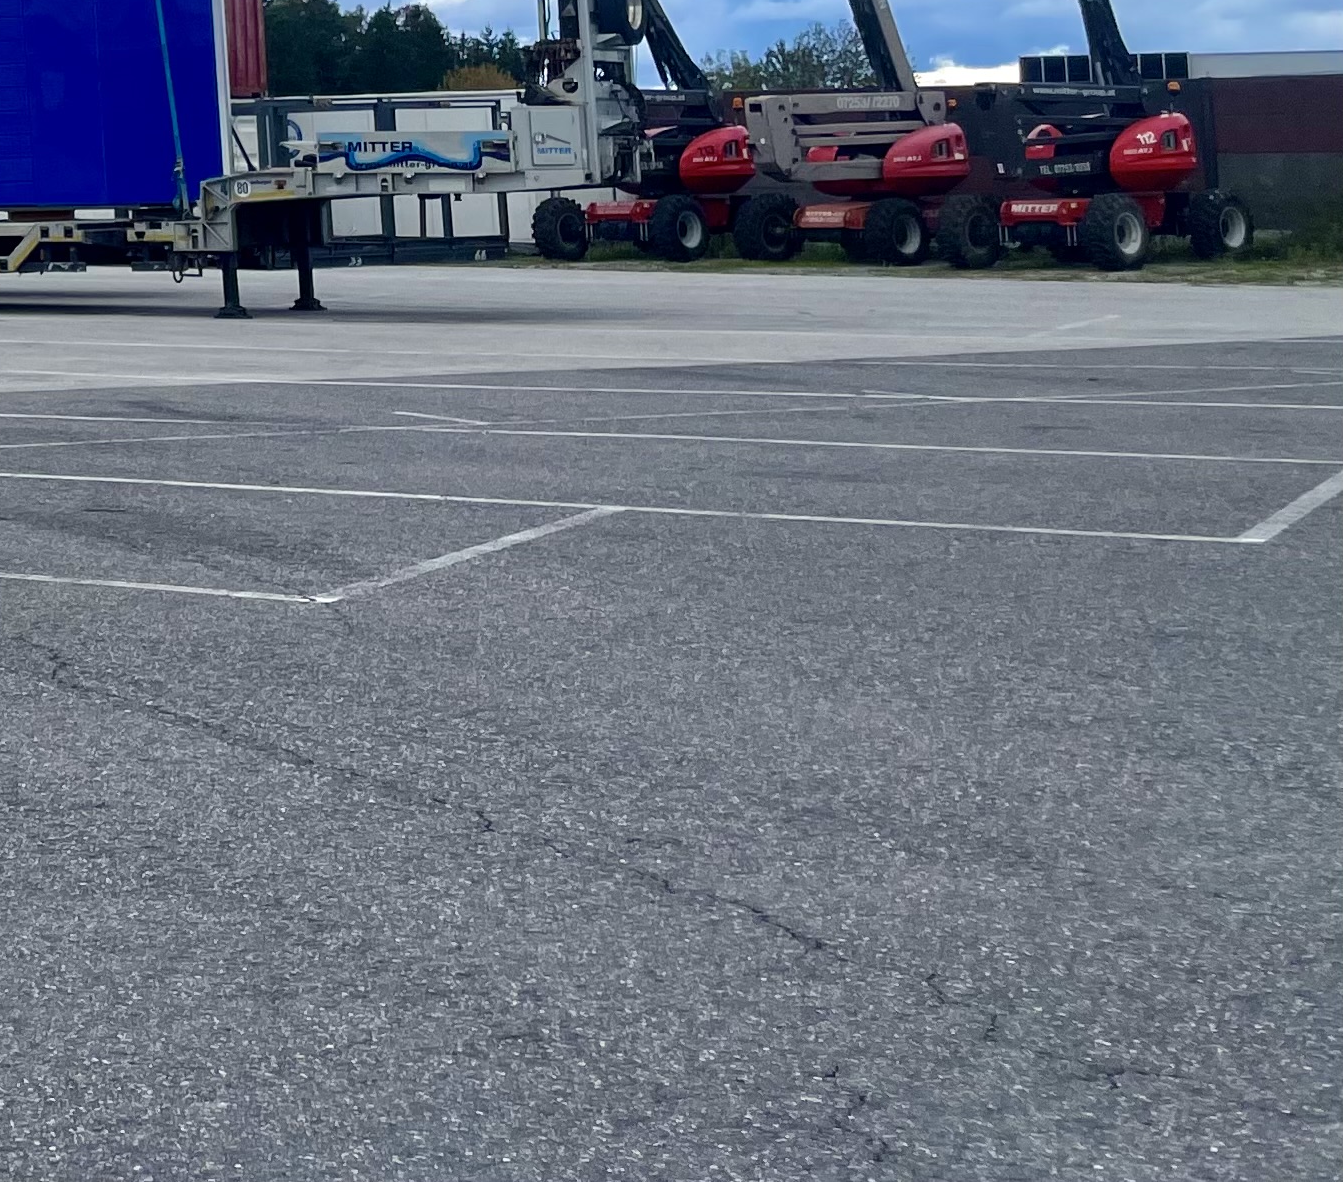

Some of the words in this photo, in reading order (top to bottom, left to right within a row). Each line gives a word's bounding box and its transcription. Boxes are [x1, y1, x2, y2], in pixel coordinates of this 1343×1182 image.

[347, 141, 413, 153] MITTER
[537, 147, 572, 155] MITTER
[236, 180, 250, 195] 80
[1011, 204, 1059, 214] MITTER
